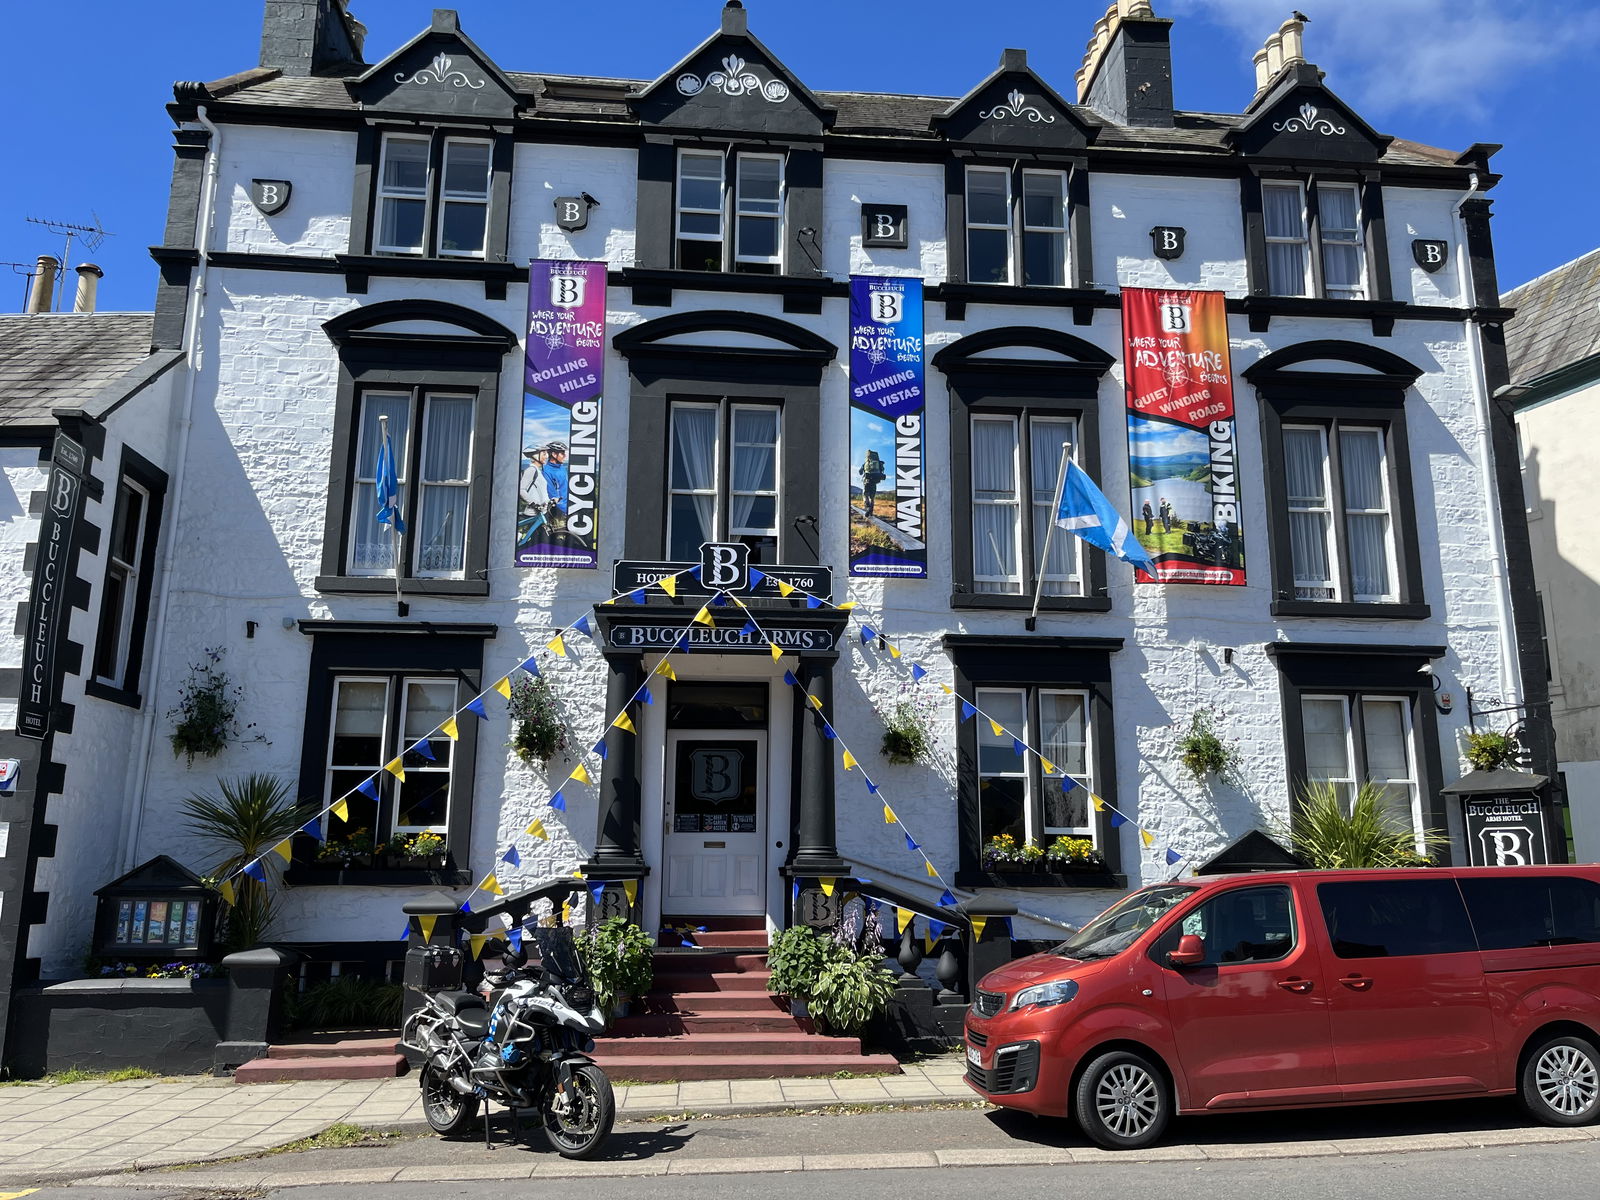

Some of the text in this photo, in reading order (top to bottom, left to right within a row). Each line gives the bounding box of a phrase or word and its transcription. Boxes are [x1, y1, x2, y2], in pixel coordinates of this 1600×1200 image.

[260, 184, 278, 205] B
[563, 202, 580, 222] B
[875, 214, 895, 238] B
[1161, 229, 1178, 250] B
[1424, 244, 1441, 263] B
[557, 278, 579, 303] B
[532, 310, 576, 321] WHERE YOUR
[877, 294, 897, 319] B
[1168, 306, 1186, 330] B
[529, 321, 603, 339] ADVENTURE
[853, 325, 895, 337] WHERE YOUR
[852, 335, 922, 353] ADVENTURE
[1128, 336, 1182, 349] WHERE YOUR
[531, 358, 589, 383] ROLLING
[1135, 350, 1222, 372] ADVENTURE
[559, 373, 597, 394] HILLS
[854, 369, 916, 398] STUNNING
[878, 386, 920, 407] VISTAS
[1134, 387, 1169, 409] QUIET
[1159, 389, 1211, 414] WINDING
[1188, 402, 1226, 421] ROADS
[567, 400, 598, 537] CYCLING
[896, 415, 921, 538] WALKING
[1209, 420, 1237, 523] BIKING
[53, 473, 71, 511] B
[708, 545, 740, 586] B
[636, 572, 680, 584] HOT
[789, 577, 814, 588] 1760
[30, 521, 61, 704] BUCCLEUCH
[630, 627, 752, 645] BUCCLEUCH
[757, 630, 814, 649] ARMS
[25, 716, 41, 727] HOTEL
[701, 754, 731, 794] B
[1468, 802, 1539, 816] BUCCLEUCH
[810, 893, 831, 921] B
